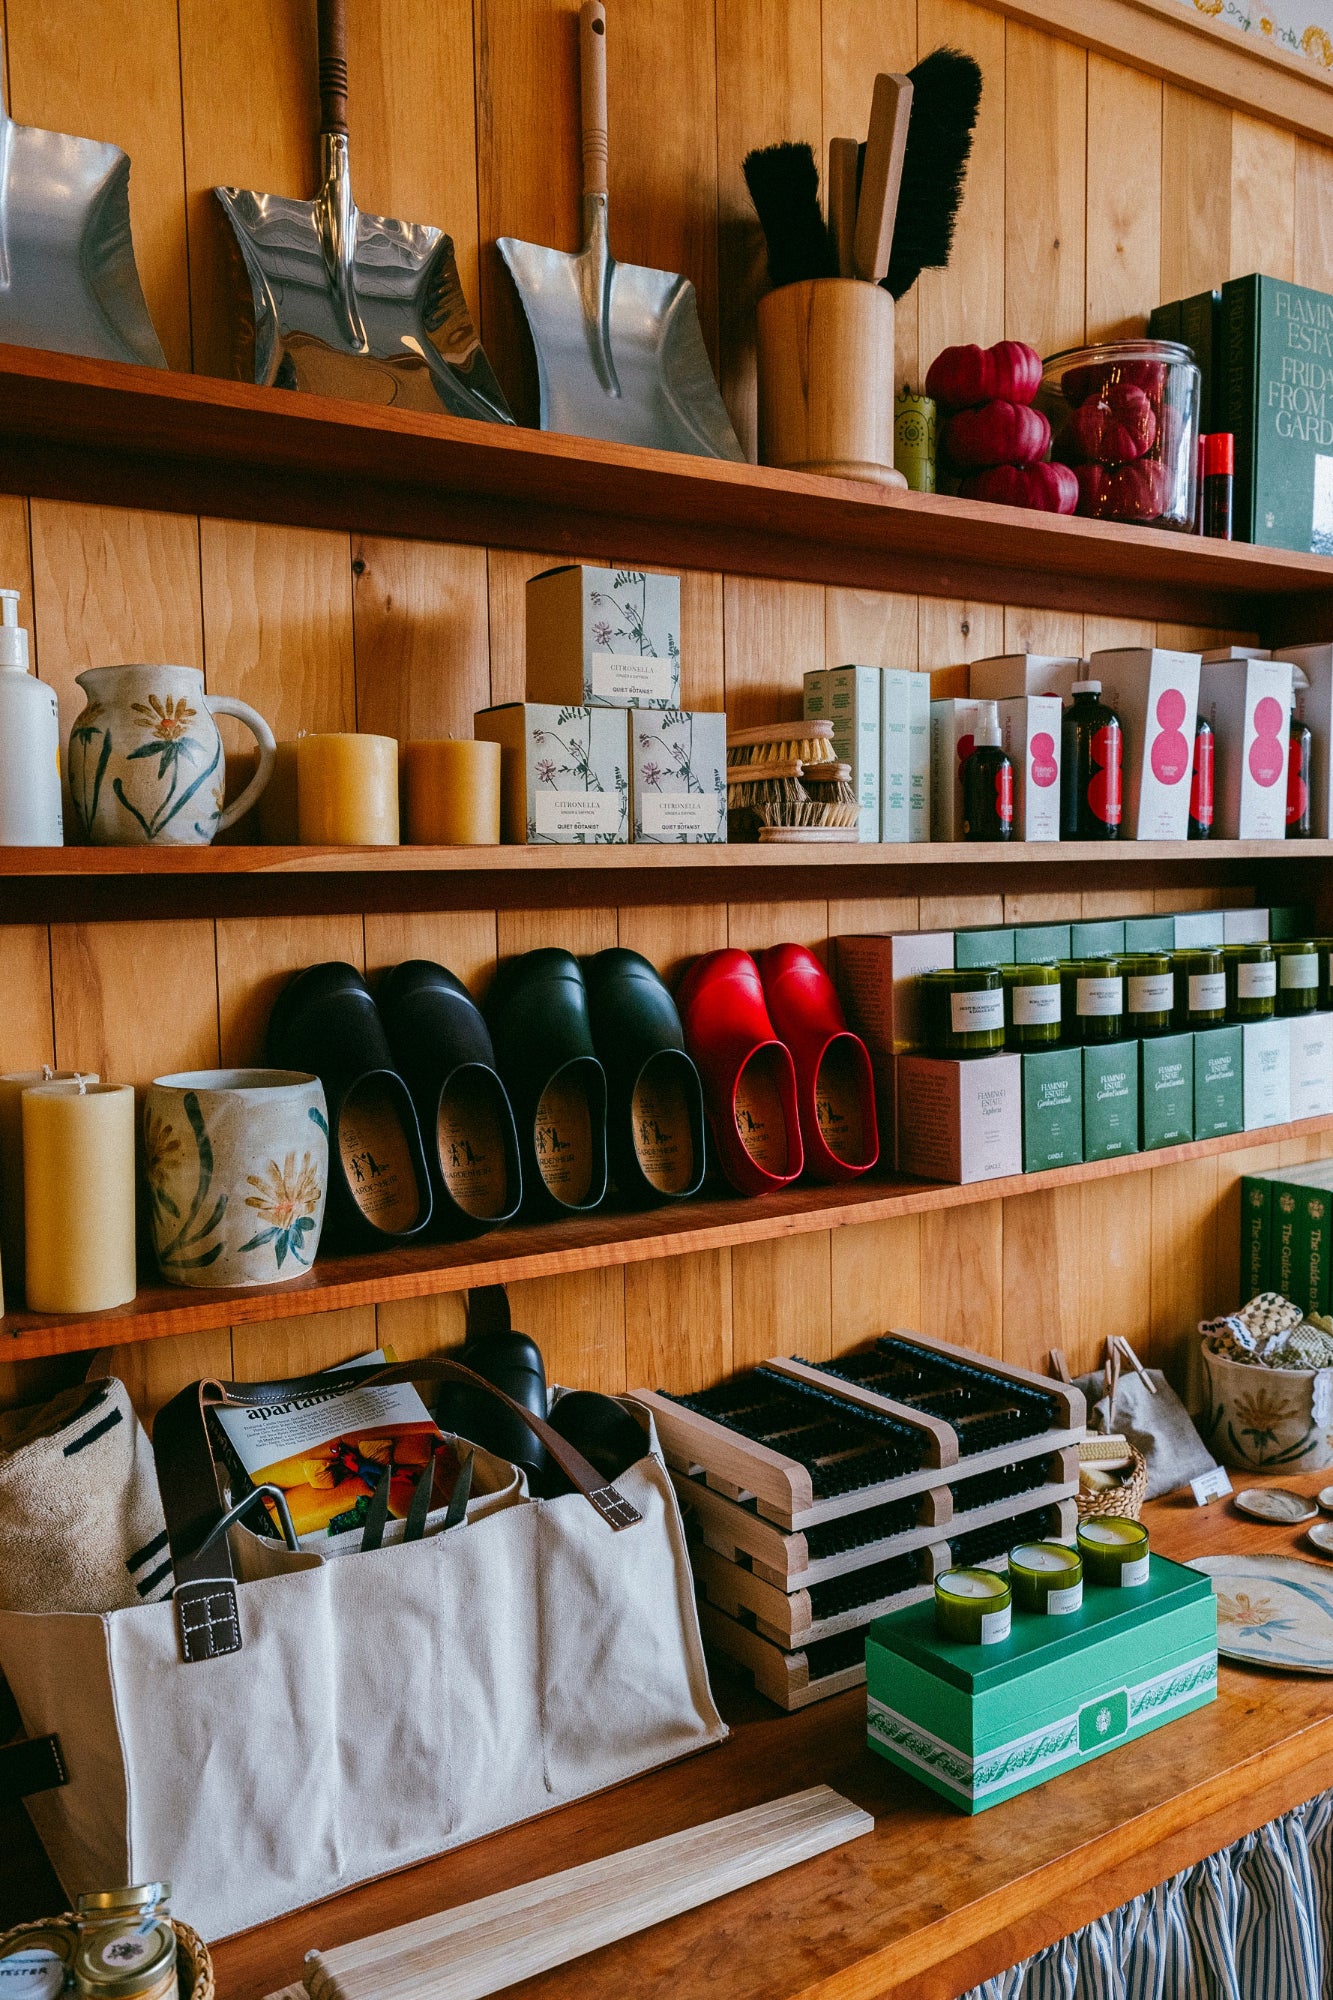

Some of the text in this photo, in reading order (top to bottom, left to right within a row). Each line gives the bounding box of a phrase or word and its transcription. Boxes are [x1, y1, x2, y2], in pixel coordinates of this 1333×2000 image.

[1288, 322, 1333, 358] ESTA
[1268, 381, 1325, 418] FROM
[1276, 410, 1333, 445] GARD
[610, 664, 654, 675] CITRONELLA
[612, 686, 653, 695] QUIET BOTANIST
[554, 801, 600, 809] CITRONELLA
[977, 1089, 1006, 1100] FLAMINGO
[1041, 1080, 1069, 1092] FLAMINGO
[1044, 1089, 1065, 1099] ESTATE
[538, 1153, 575, 1166] RDENHEIR
[352, 1174, 398, 1196] ARDENHEIR
[1282, 1223, 1292, 1245] The
[1310, 1229, 1321, 1251] The
[1281, 1246, 1292, 1279] Guide
[1310, 1252, 1321, 1286] Guide
[1309, 1287, 1318, 1299] to
